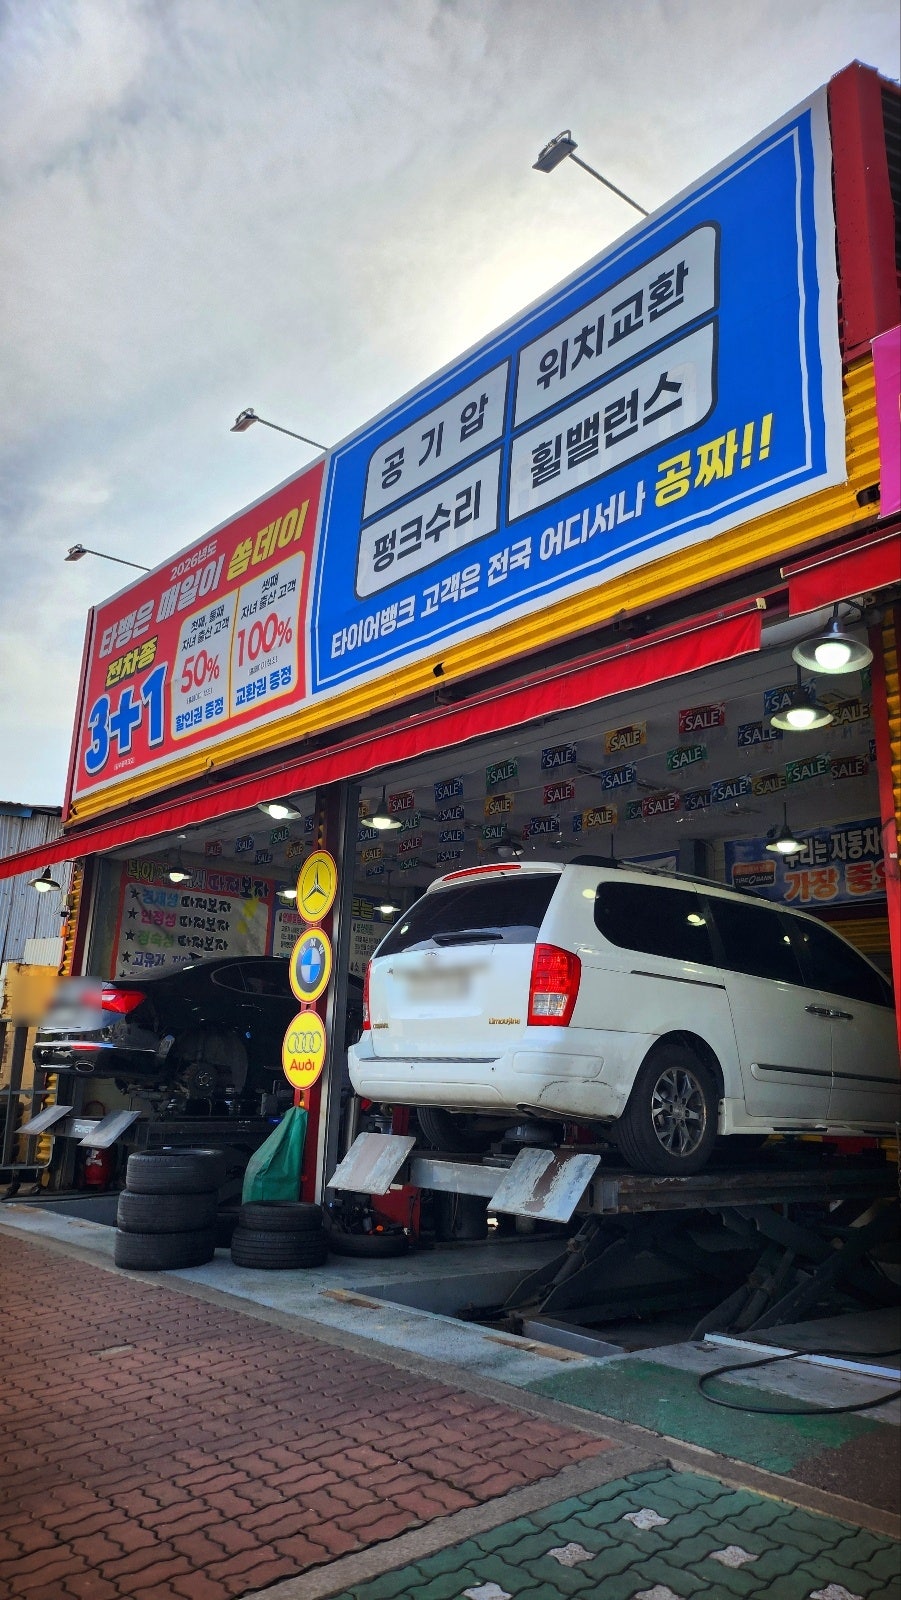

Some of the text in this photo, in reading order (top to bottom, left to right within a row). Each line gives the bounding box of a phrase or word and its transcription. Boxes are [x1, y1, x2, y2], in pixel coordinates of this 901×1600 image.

[536, 261, 690, 390] 위치교환
[530, 371, 683, 490] 휠밸런스
[330, 412, 774, 659] 타이어뱅크 고객은 전국 어디서나 공짜!!
[373, 481, 483, 573] 펑크수리
[169, 540, 218, 582] 2026년도
[261, 571, 280, 594] 셋째
[98, 600, 155, 659] 타뱅은
[156, 553, 226, 623] 매일이
[240, 578, 297, 620] 자녀 출산 고객
[209, 604, 225, 623] 둘째
[181, 616, 230, 652] 자녀 출산 고객
[237, 612, 293, 668] 100%
[105, 635, 159, 690] 전차종
[180, 649, 220, 694] 50%
[235, 675, 267, 707] 교환권
[269, 664, 292, 691] 증정
[85, 662, 169, 774] 3+1
[175, 696, 224, 733] 할인권 증정
[685, 710, 719, 731] SALE
[610, 730, 641, 751] SALE
[744, 727, 778, 746] SALE
[546, 749, 572, 768] SALE
[672, 748, 702, 769] SALE
[490, 766, 514, 784] SALE
[606, 769, 633, 789] SALE
[793, 759, 826, 781] SALE
[831, 761, 864, 779] SALE
[437, 784, 460, 800] SALE
[547, 785, 571, 803] SALE
[718, 781, 747, 800] SALE
[756, 777, 787, 796] SALE
[391, 798, 412, 813] SALE
[489, 800, 512, 816] SALE
[649, 798, 676, 815] SALE
[691, 794, 713, 810] SAL
[441, 807, 462, 822] SALE
[587, 810, 613, 826] SALE
[630, 805, 643, 819] SA
[401, 817, 419, 832] SALE
[533, 820, 556, 834] SALE
[272, 829, 289, 844] SALE
[360, 828, 377, 841] SALE
[402, 837, 420, 851] SALE
[442, 829, 461, 842] SALE
[830, 827, 884, 860] 자동차
[238, 840, 253, 852] SALE
[364, 848, 382, 861] SALE
[441, 849, 458, 861] SALE
[784, 865, 840, 902] 가장
[299, 937, 325, 956] BMW
[132, 951, 166, 968] 고유가
[488, 1017, 521, 1026] Limousine
[289, 1058, 316, 1071] Audi
